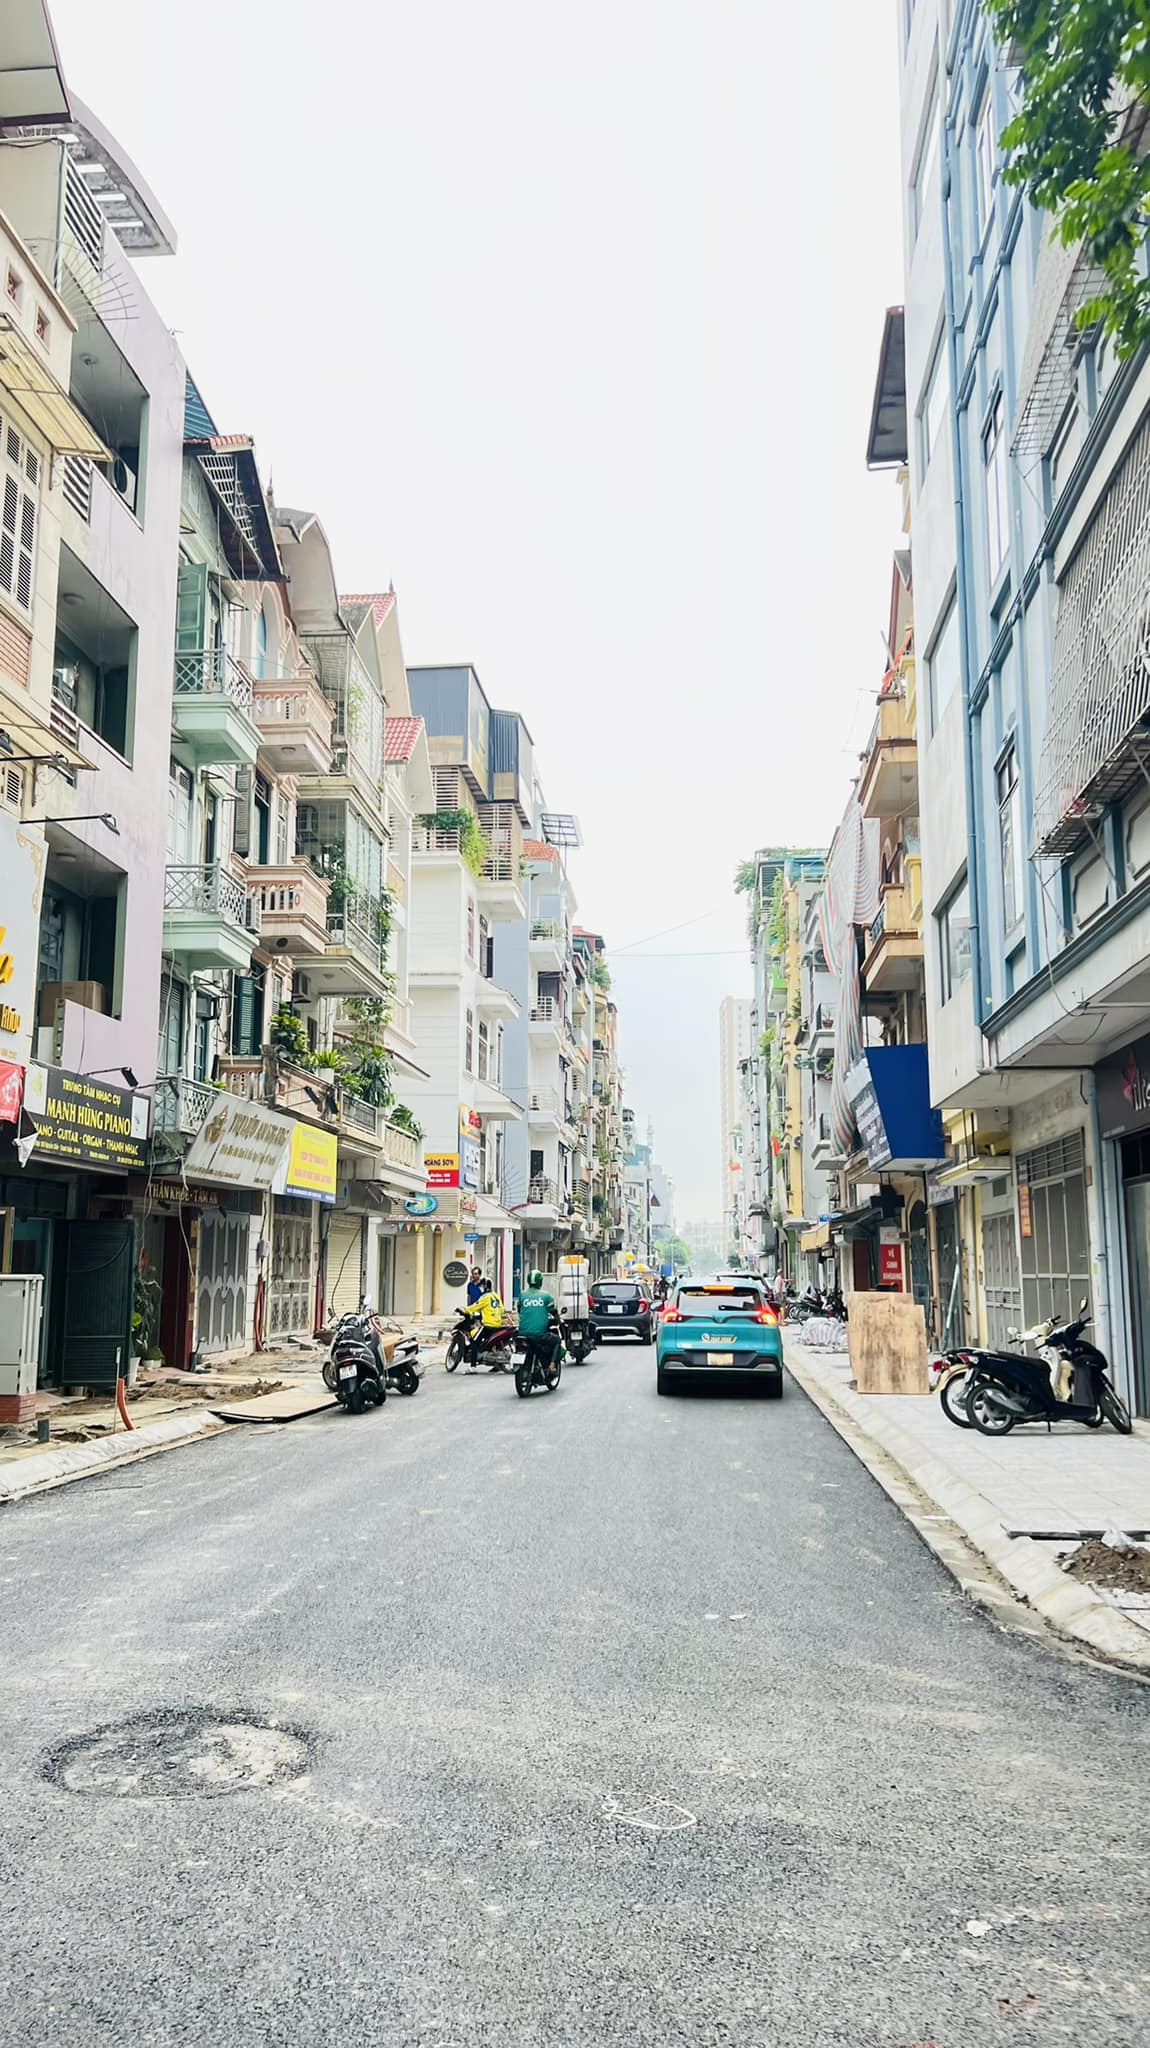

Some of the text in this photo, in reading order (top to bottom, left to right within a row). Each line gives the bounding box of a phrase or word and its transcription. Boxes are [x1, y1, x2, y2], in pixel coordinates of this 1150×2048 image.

[62, 1079, 121, 1108] TRUNG TÂM NHẠC CỤ
[46, 1098, 131, 1136] MẠNH HÙNG PIANO
[57, 1128, 79, 1142] GUITAR
[82, 1134, 103, 1148] ORGAN
[106, 1140, 125, 1153] THANH
[523, 1298, 544, 1307] Grab
